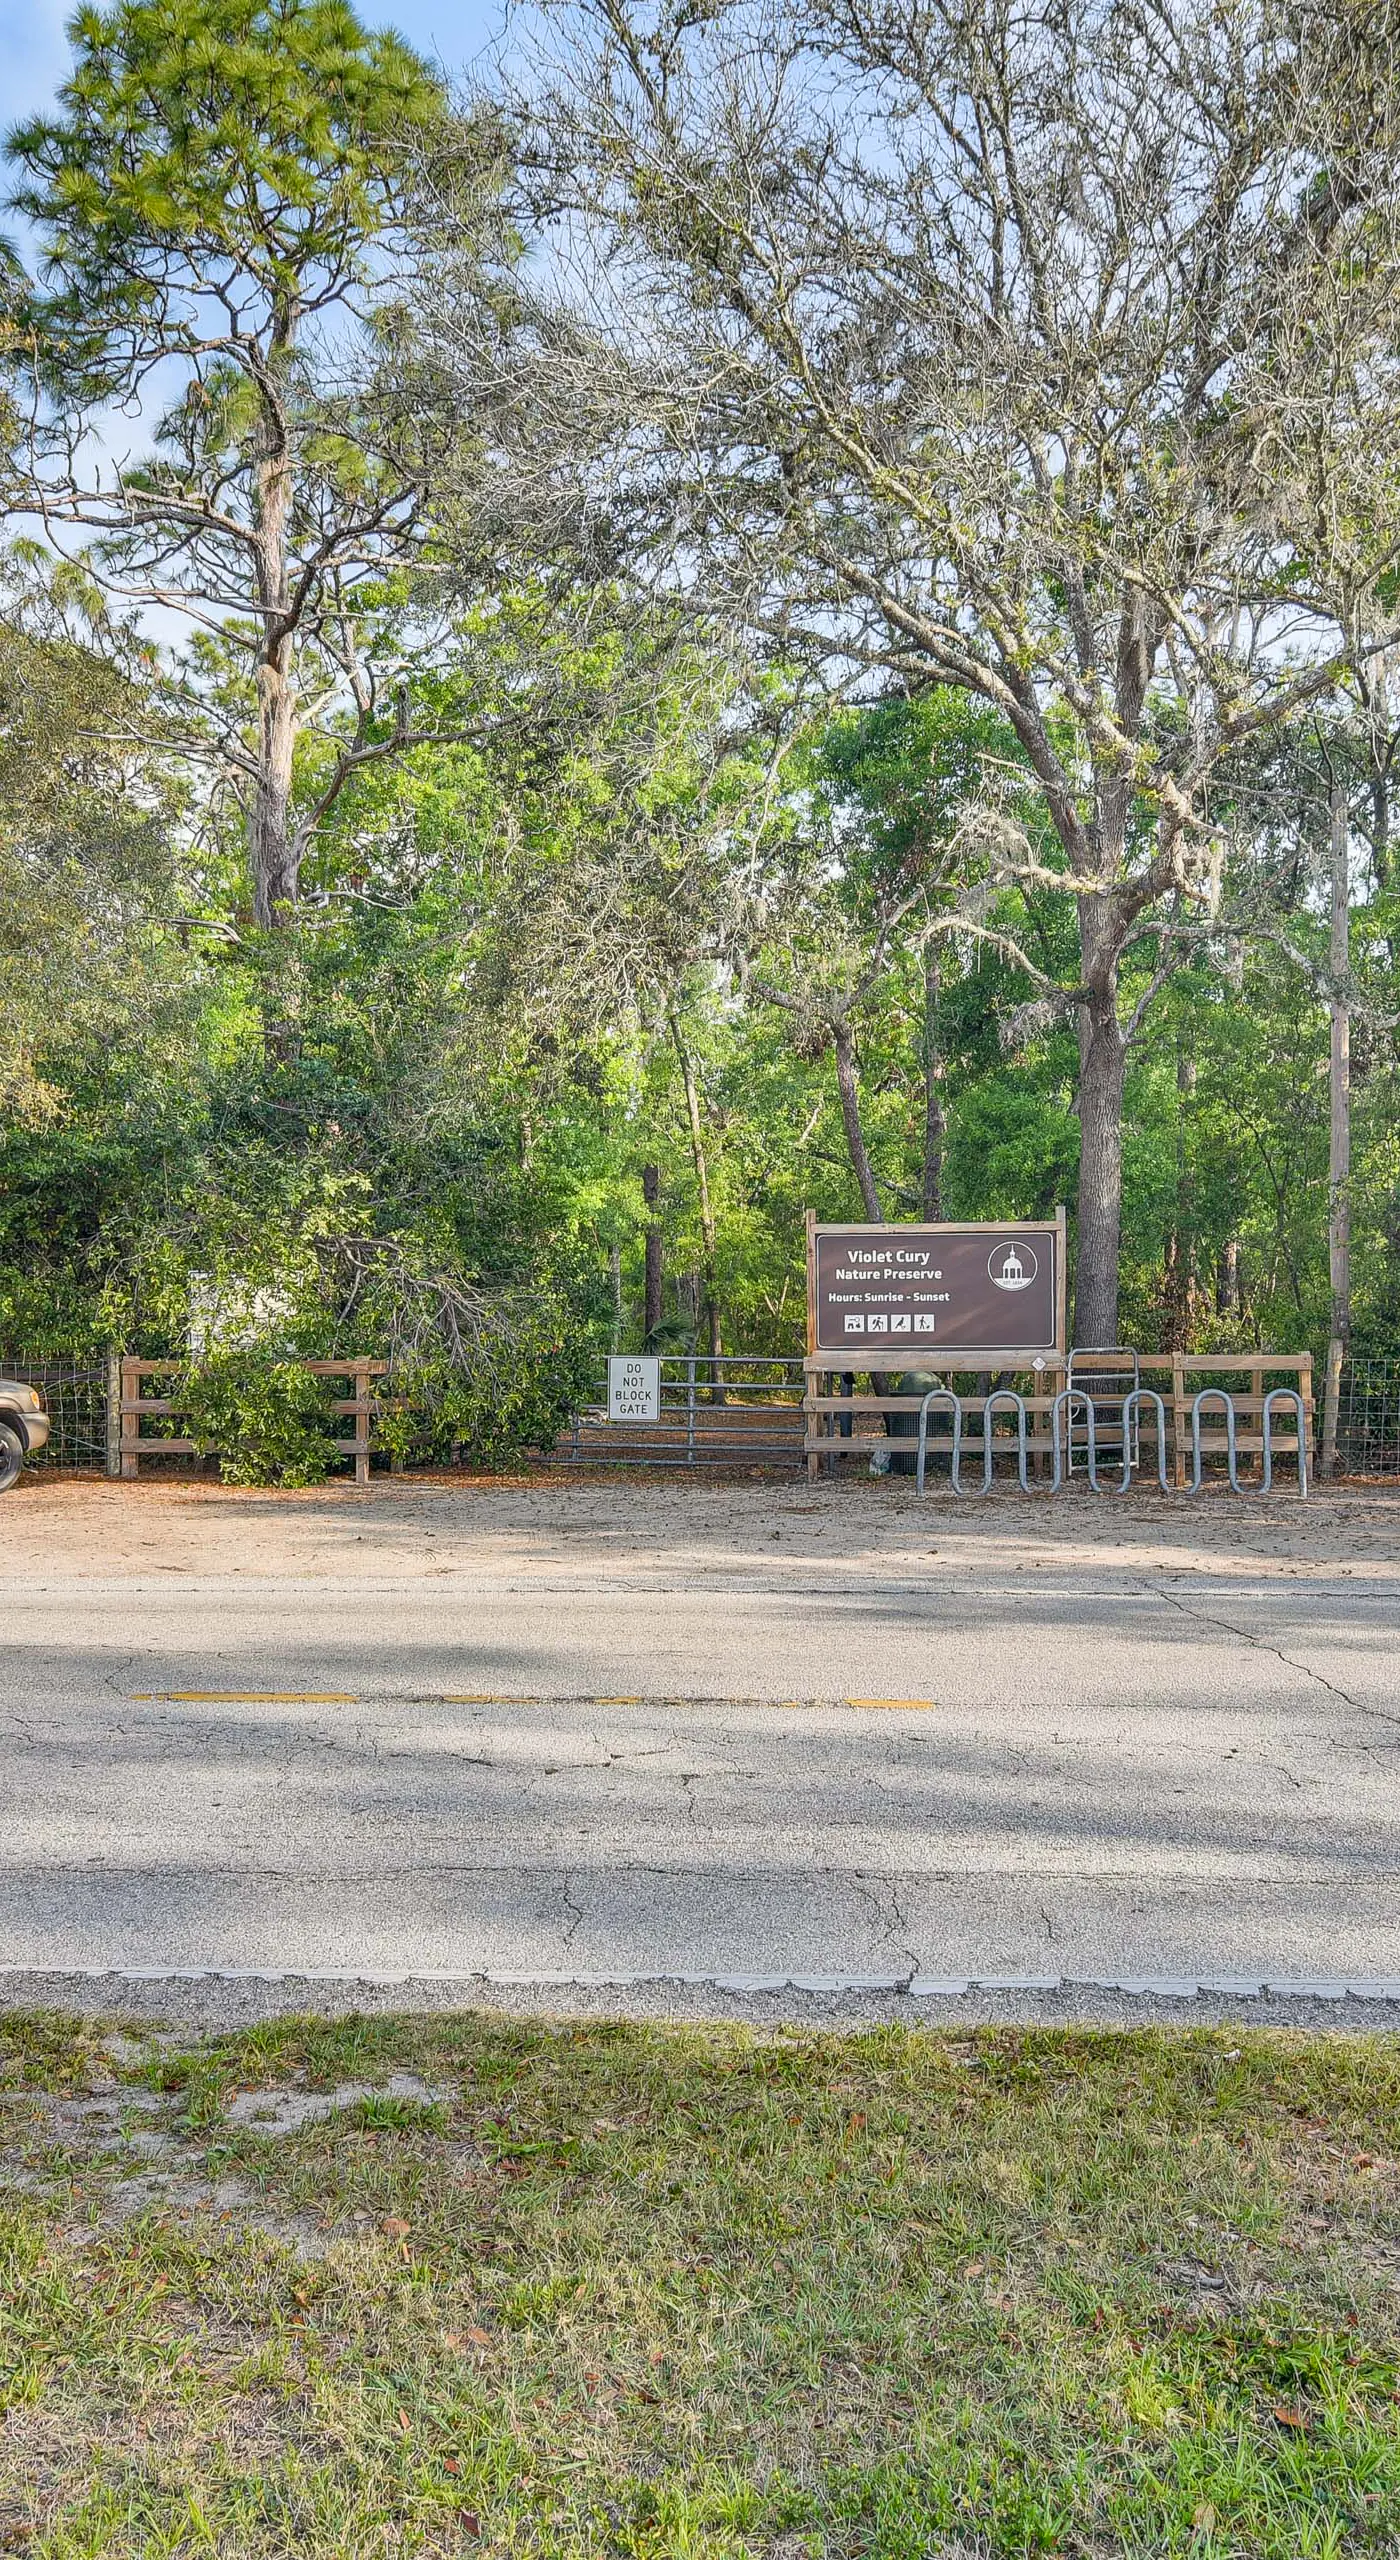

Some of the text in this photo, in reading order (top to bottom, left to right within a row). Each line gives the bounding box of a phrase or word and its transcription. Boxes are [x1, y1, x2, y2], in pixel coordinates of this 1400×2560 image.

[847, 1250, 930, 1266] Violet Cury
[836, 1268, 942, 1280] Nature Preserve
[828, 1292, 862, 1302] Hours:
[864, 1292, 904, 1302] Sunrise
[913, 1292, 950, 1302] Sunset
[627, 1363, 641, 1373] DO
[623, 1377, 644, 1387] NOT
[615, 1391, 652, 1400] BLOCK
[620, 1404, 647, 1414] GATE
